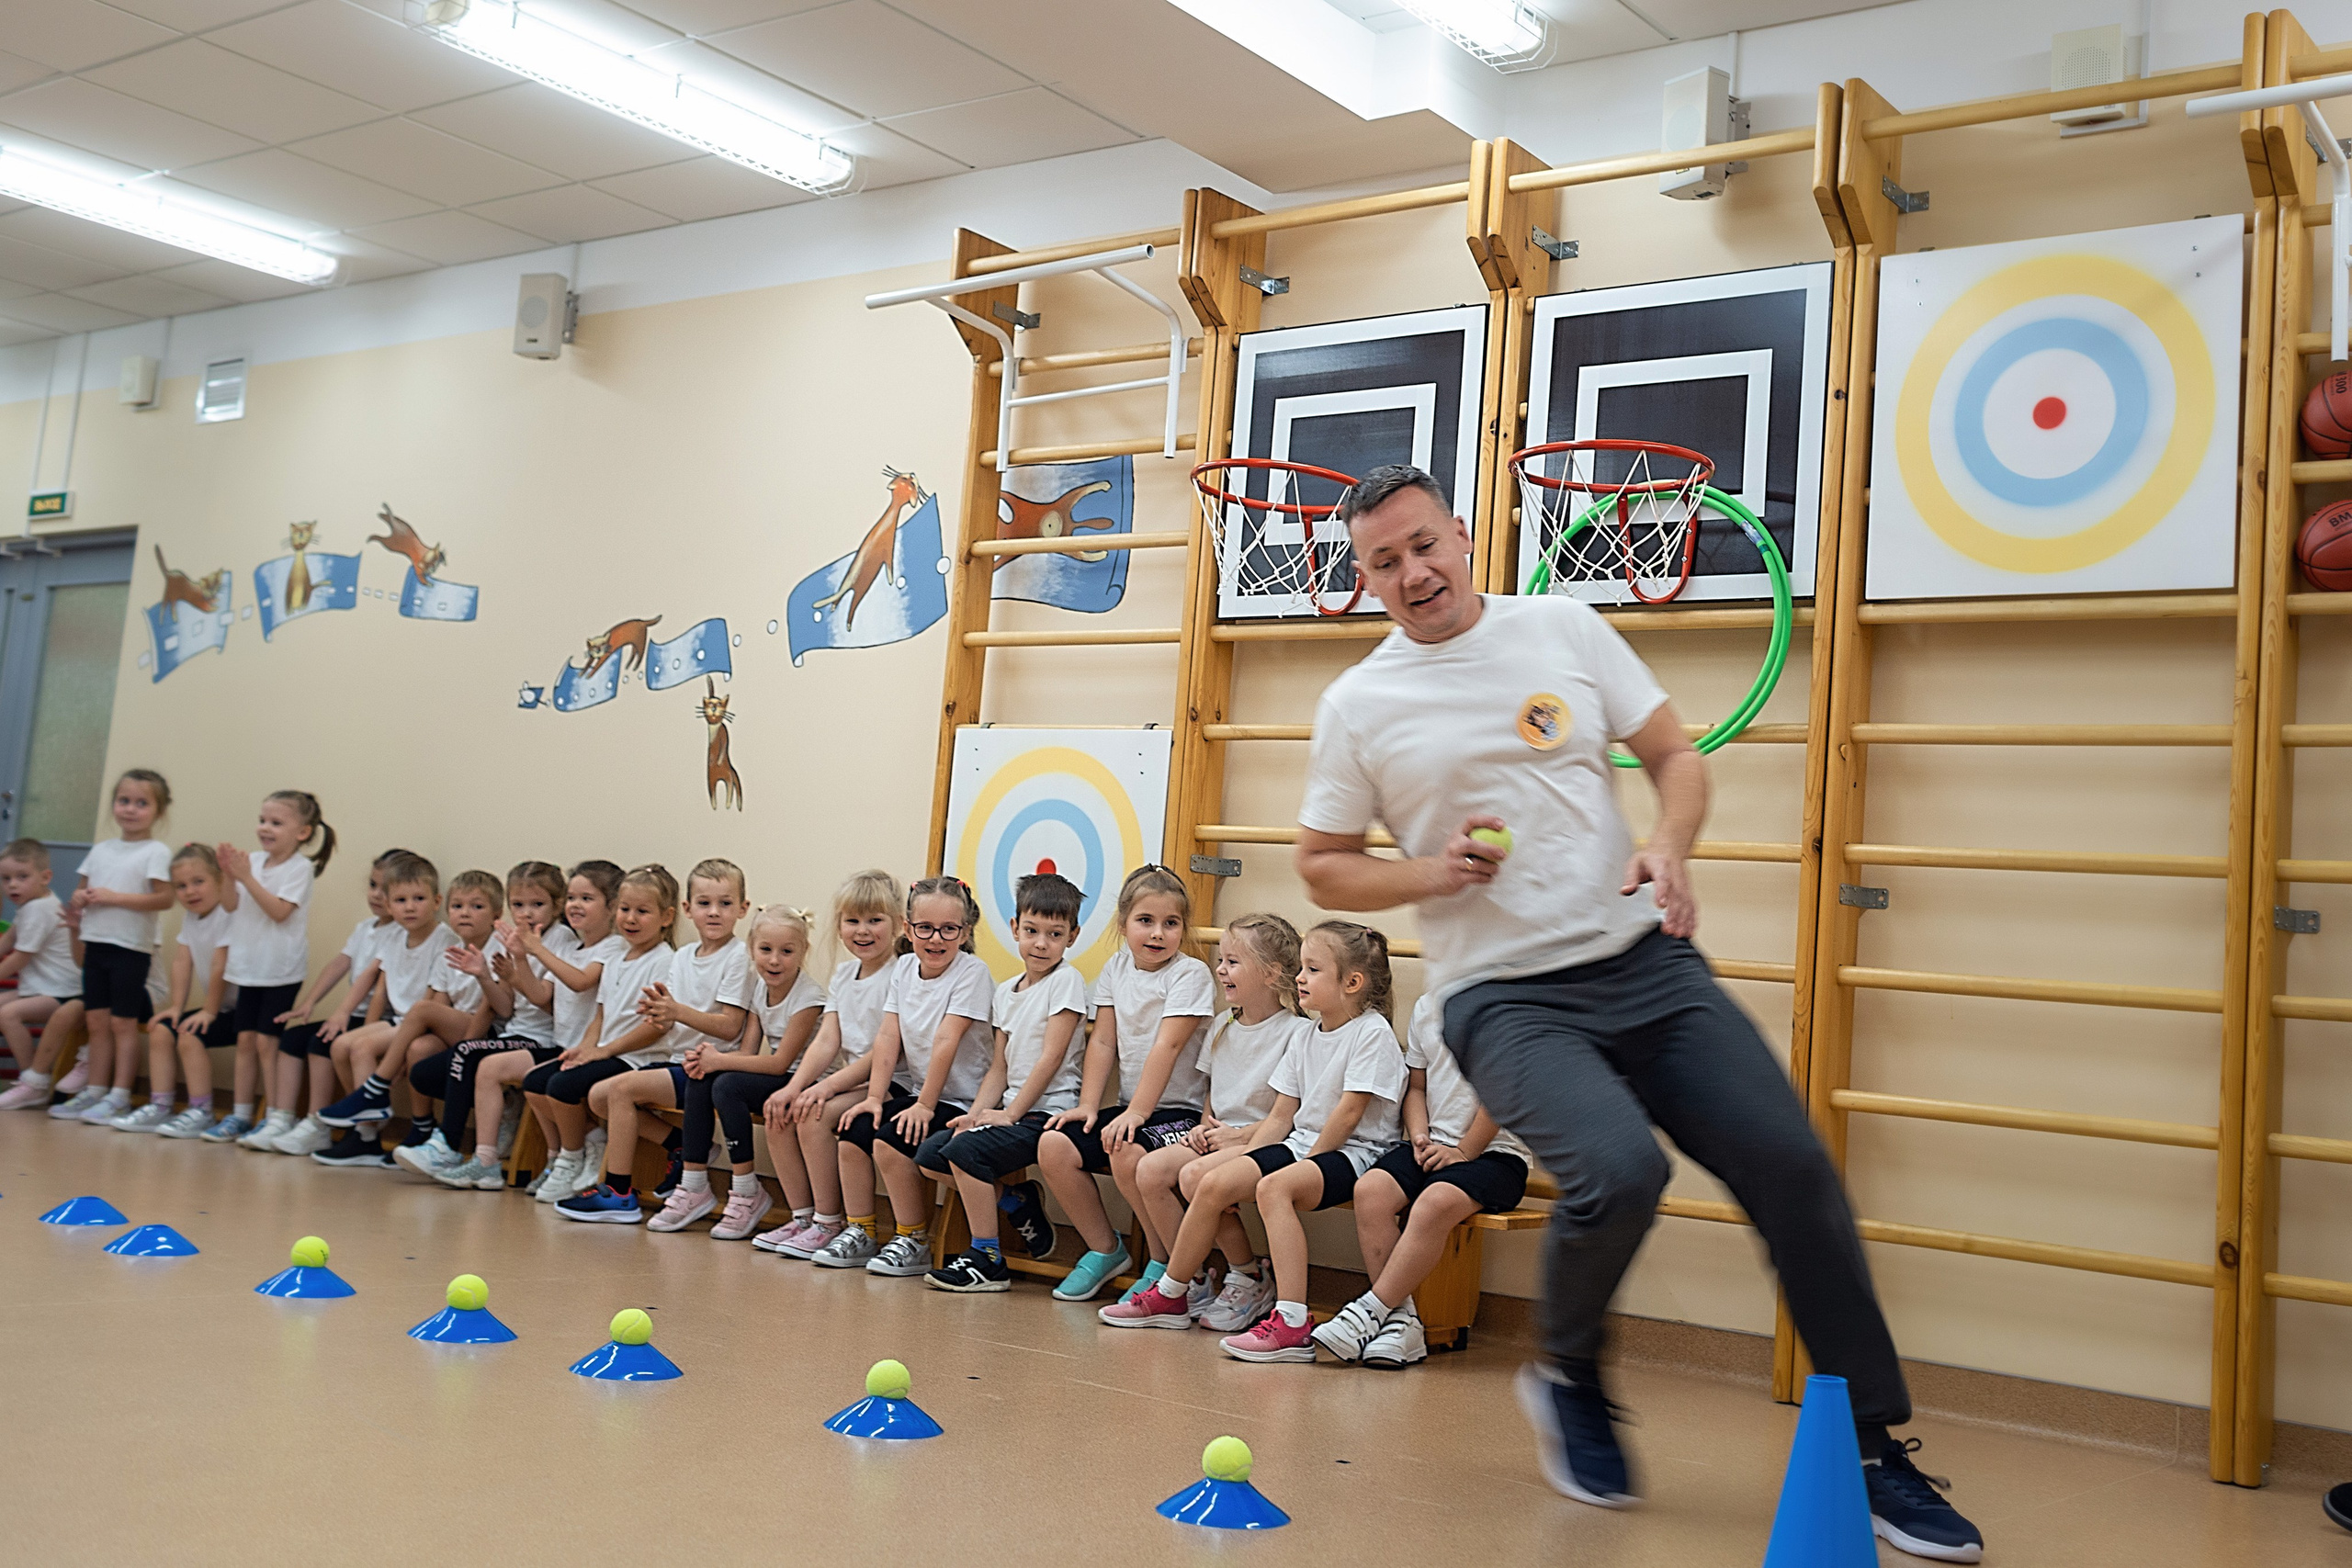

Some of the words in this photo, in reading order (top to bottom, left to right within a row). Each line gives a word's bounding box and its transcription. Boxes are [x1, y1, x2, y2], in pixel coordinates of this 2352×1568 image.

[2335, 376, 2347, 393] 300
[458, 1040, 505, 1055] BORING
[506, 1040, 537, 1049] MORE
[450, 1052, 464, 1081] ART
[1160, 1130, 1190, 1146] EVER
